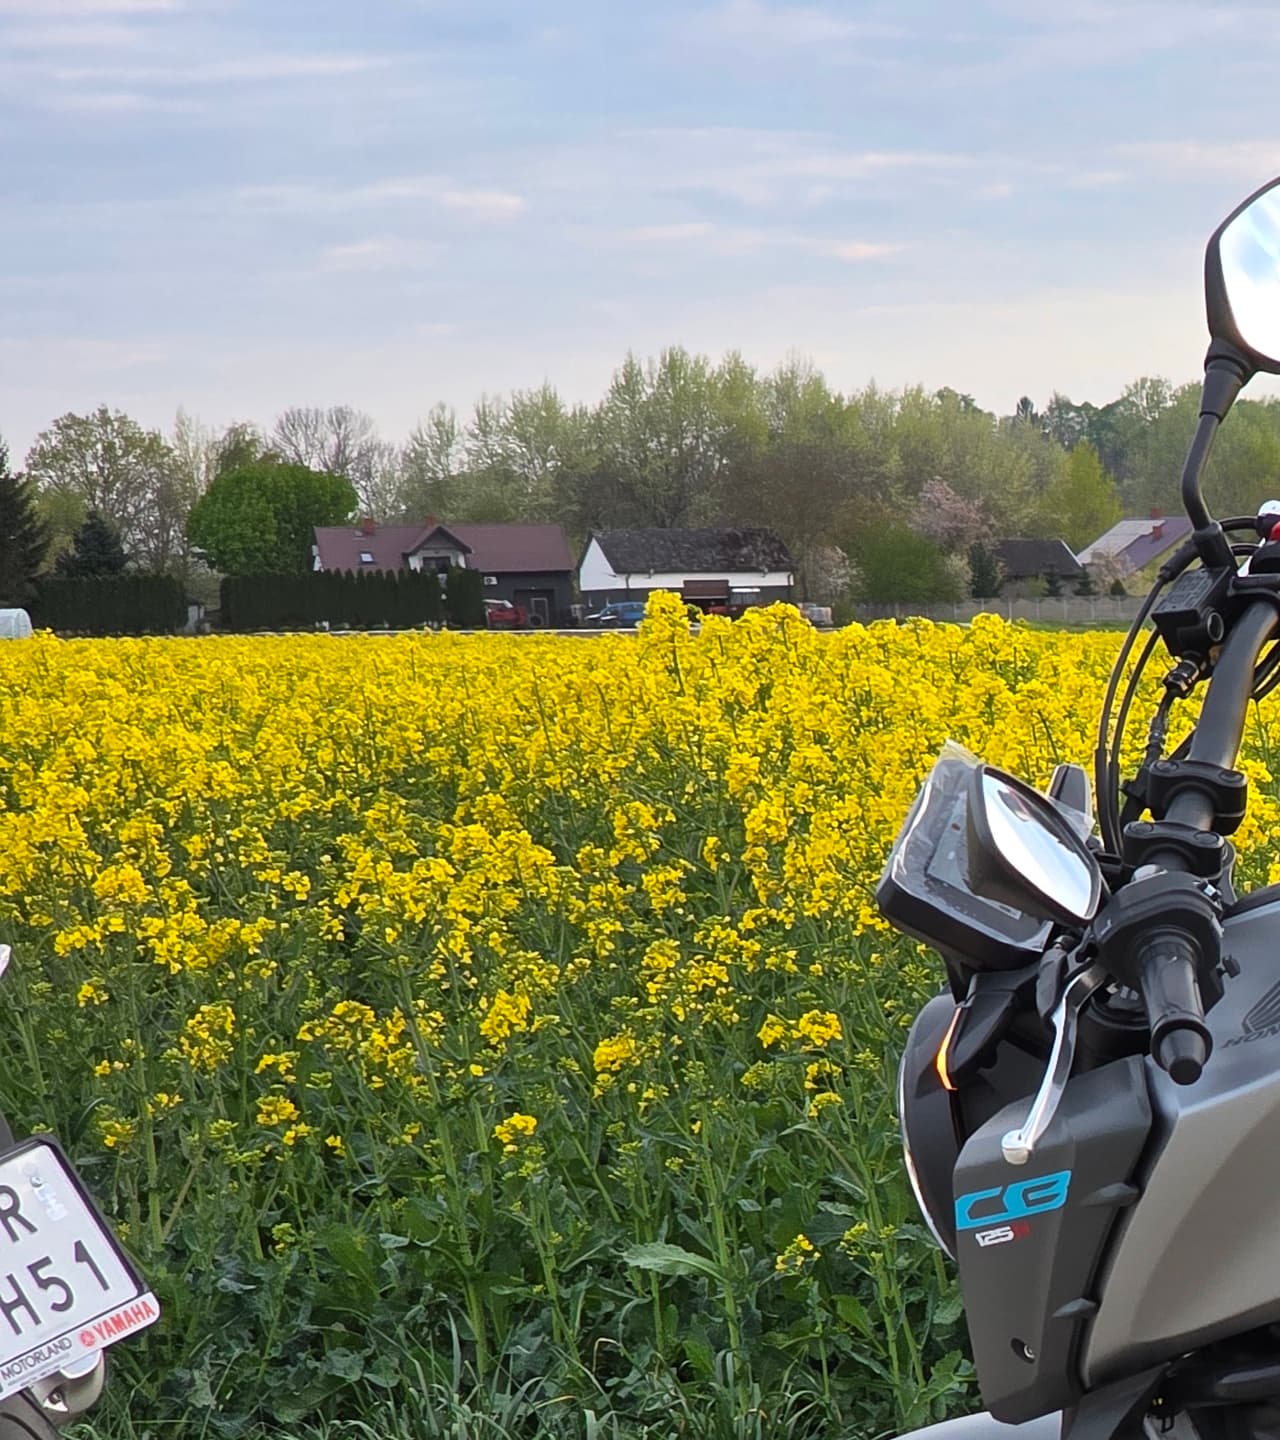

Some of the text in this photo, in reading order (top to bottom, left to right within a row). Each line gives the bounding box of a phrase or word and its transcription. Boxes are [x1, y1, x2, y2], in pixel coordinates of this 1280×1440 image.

[955, 1169, 1071, 1230] CB
[1, 1337, 73, 1381] MOTORLAND
[93, 1300, 155, 1341] YAMAHA
